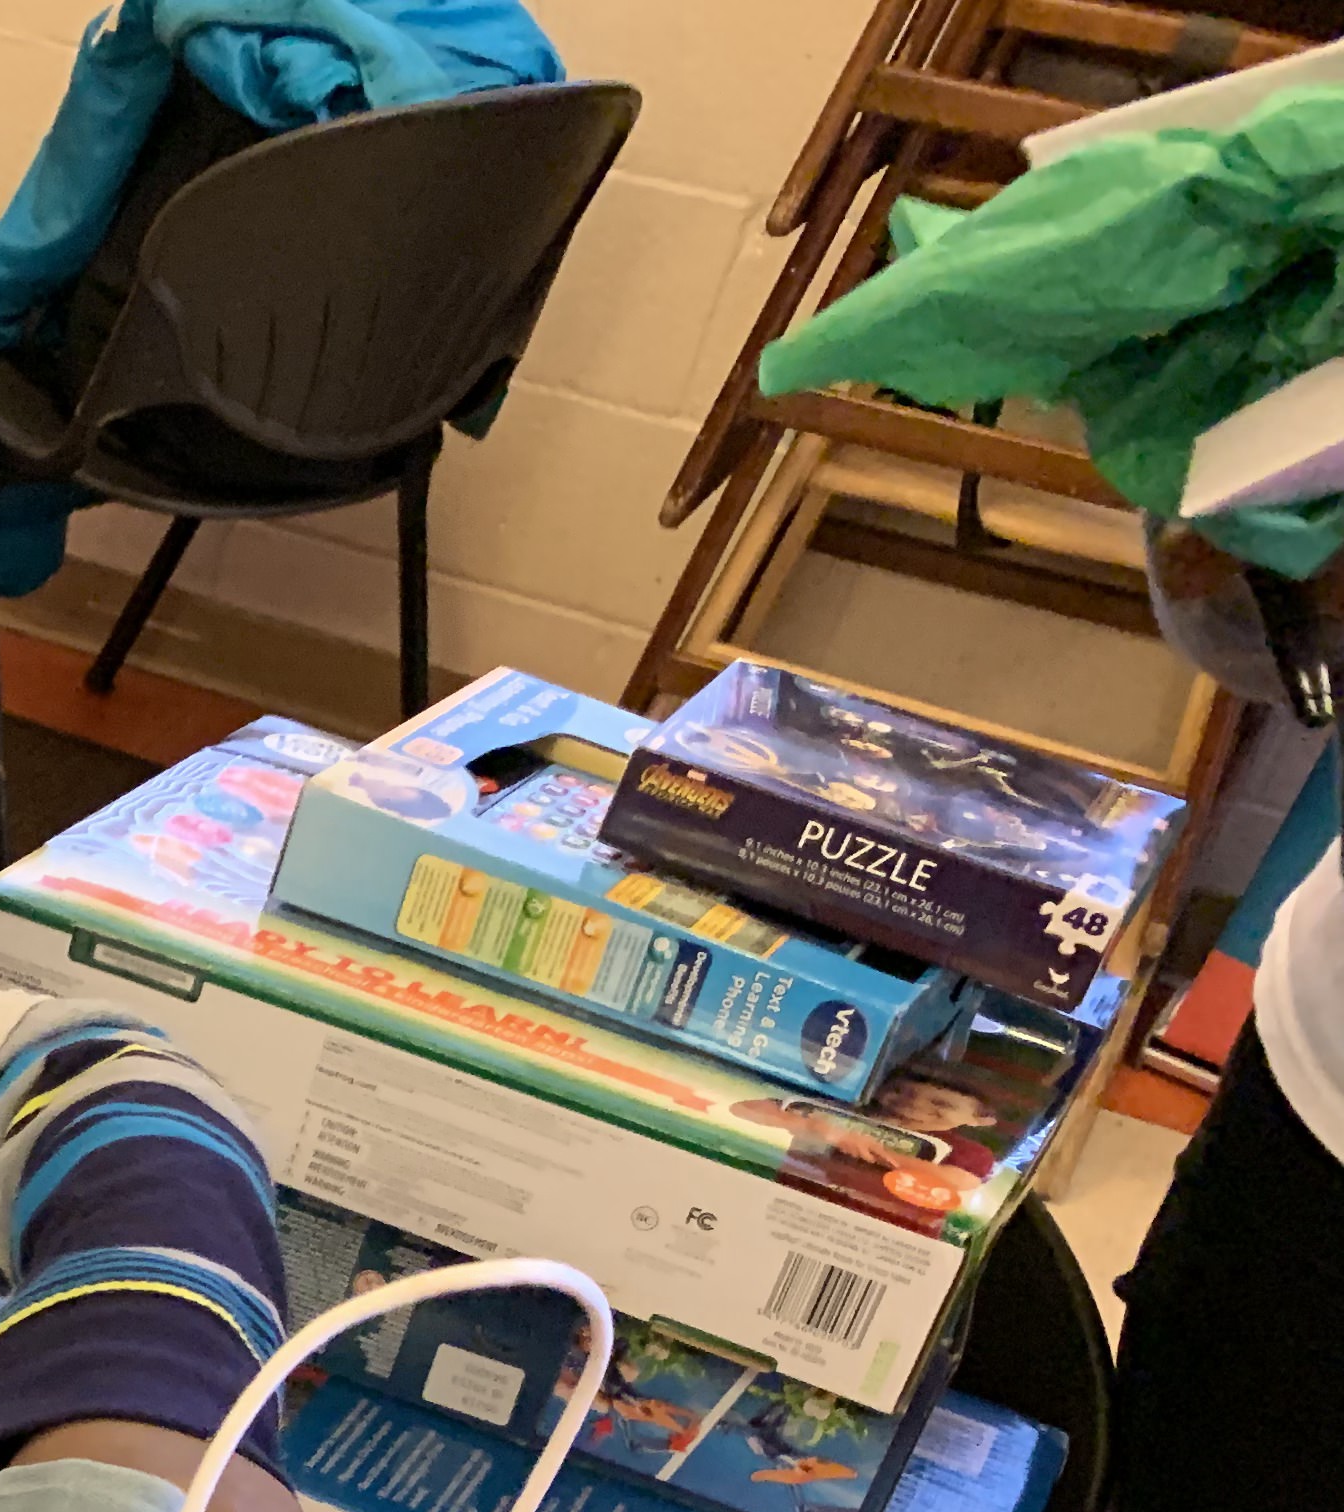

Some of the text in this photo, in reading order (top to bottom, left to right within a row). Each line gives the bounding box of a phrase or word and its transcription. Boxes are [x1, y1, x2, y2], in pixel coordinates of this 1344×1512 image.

[761, 843, 796, 864] inches
[828, 867, 862, 887] inches
[891, 890, 908, 903] cm
[942, 906, 965, 924] cm)
[796, 818, 939, 894] PUZZLE
[754, 856, 792, 878] pouces
[824, 880, 862, 903] pouces
[890, 903, 908, 917] cm
[942, 920, 965, 938] cm)
[1059, 901, 1110, 940] 48
[330, 956, 397, 983] TO
[403, 982, 589, 1050] LEARN!
[713, 974, 746, 1032] Phone
[725, 971, 771, 1048] Learning
[759, 1015, 777, 1030] &
[765, 974, 794, 1013] Text
[812, 1007, 857, 1077] vtech
